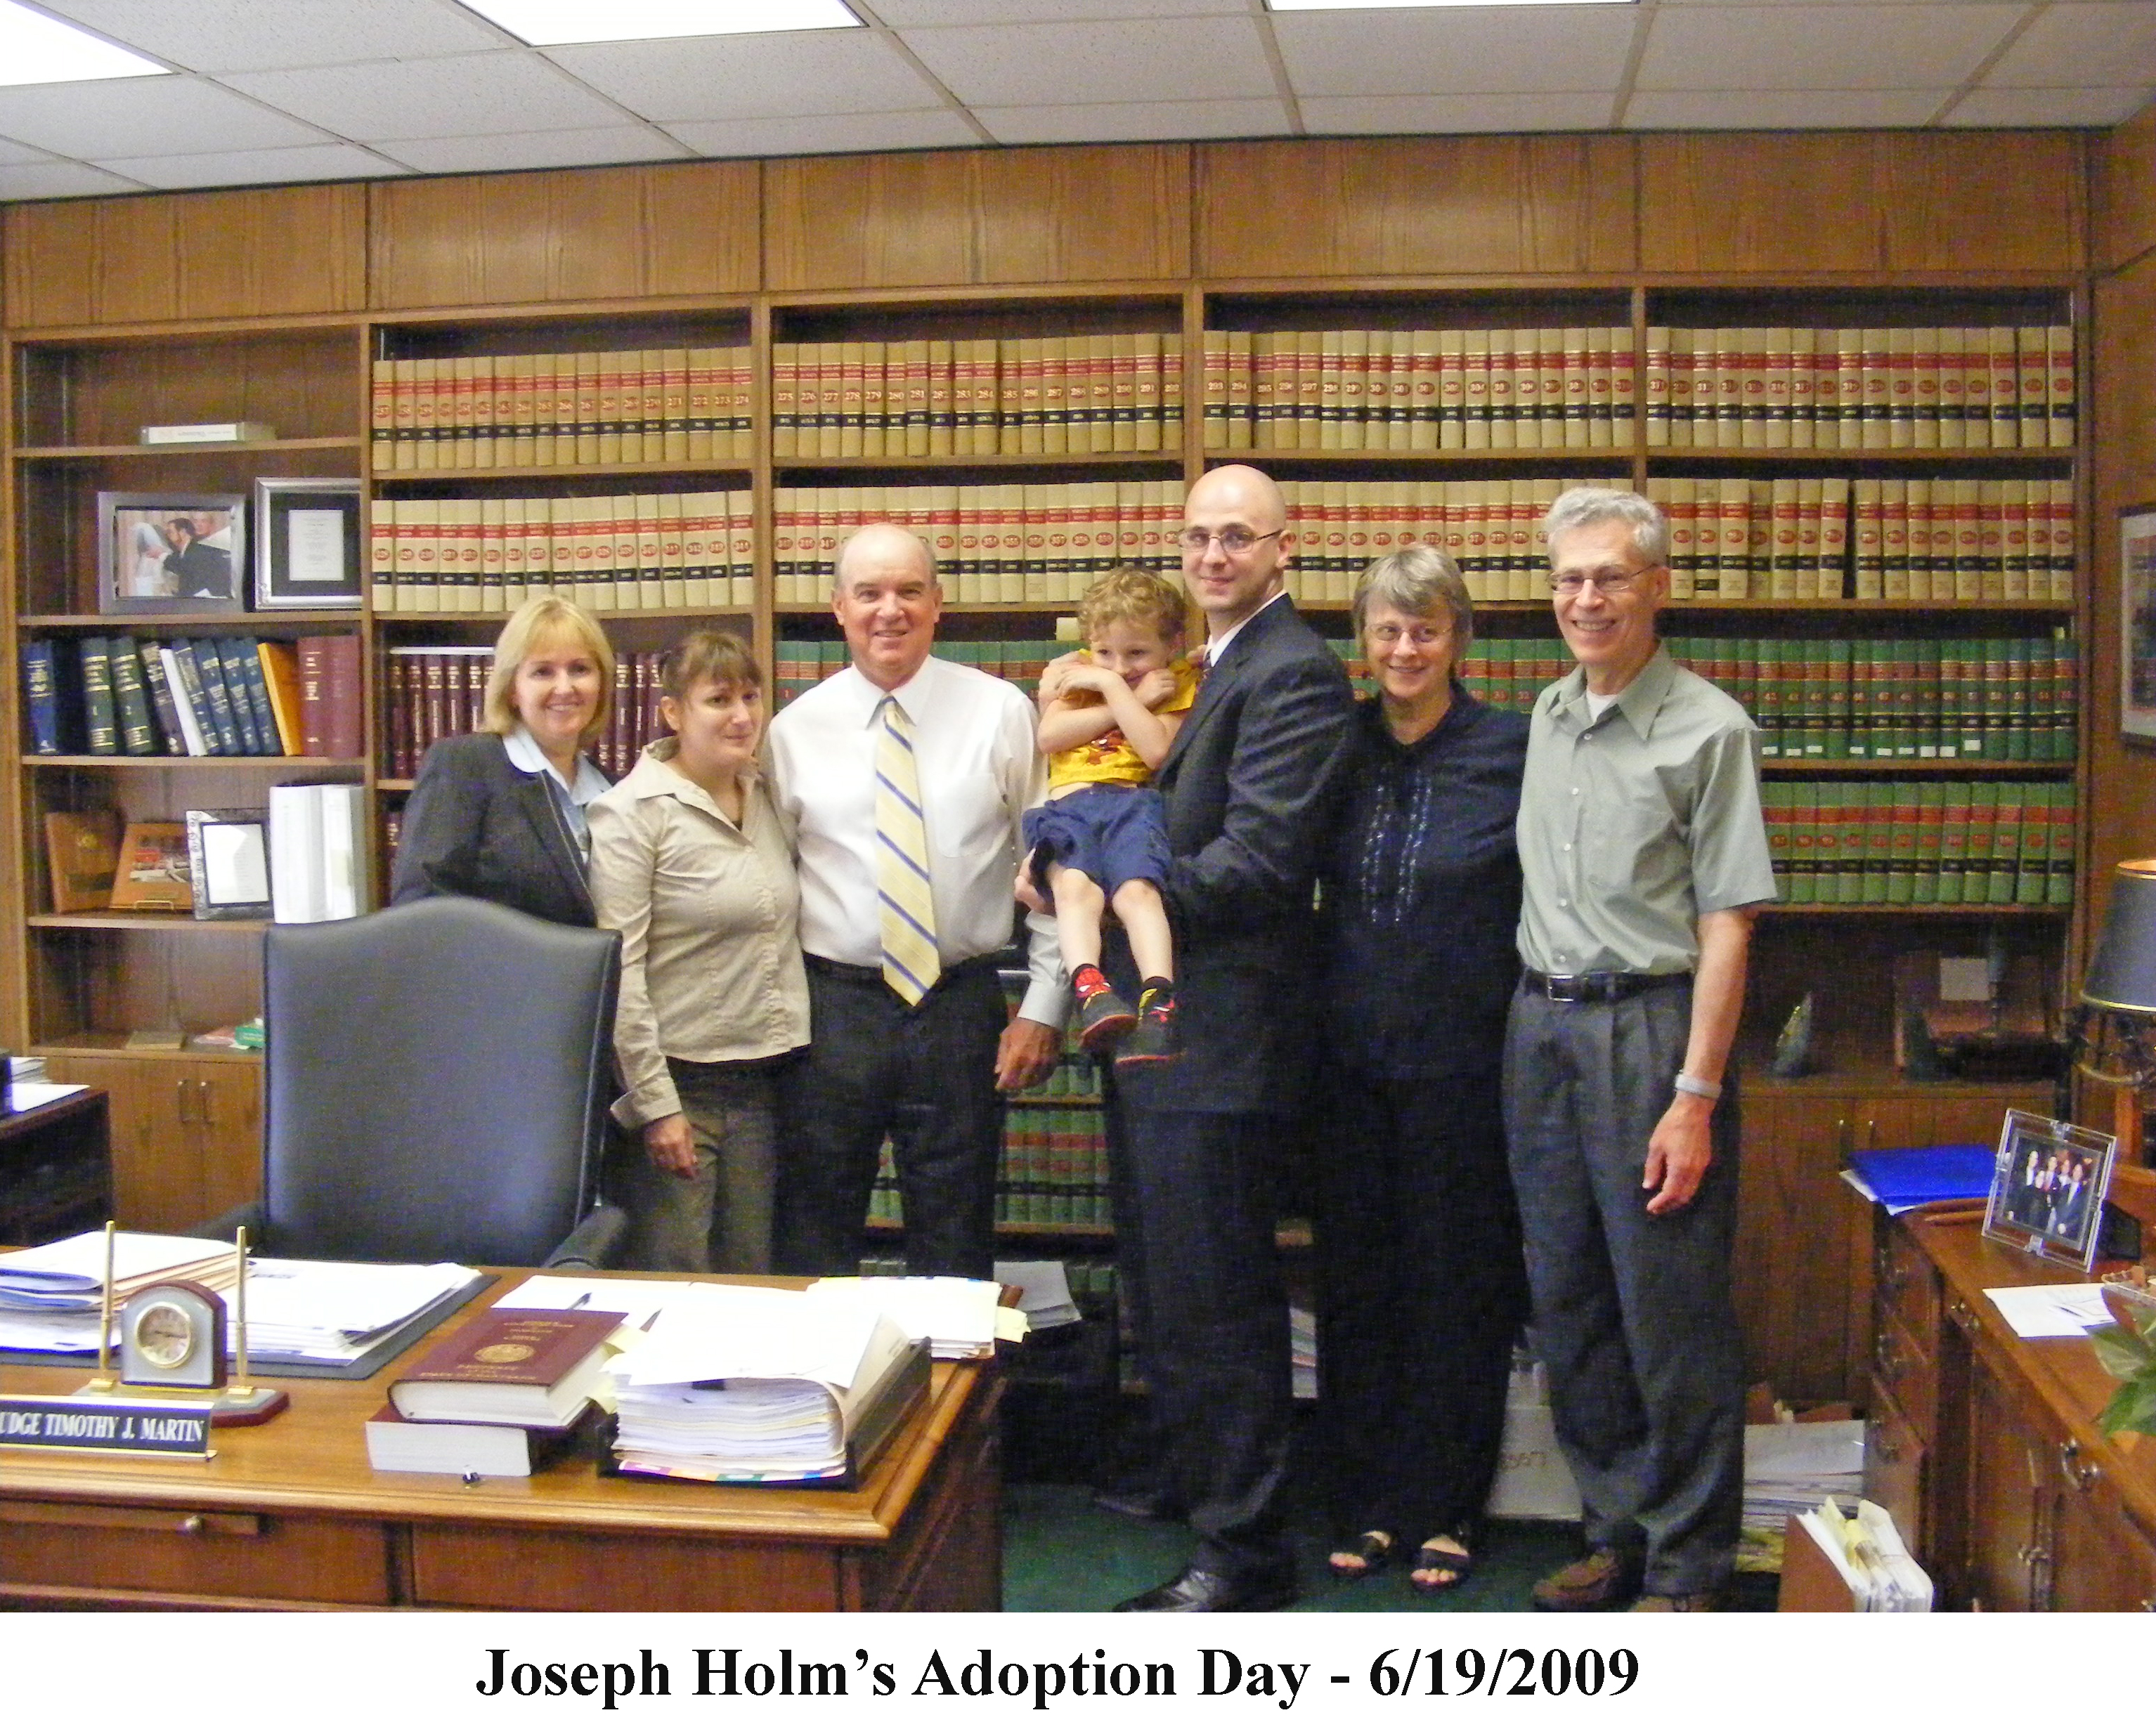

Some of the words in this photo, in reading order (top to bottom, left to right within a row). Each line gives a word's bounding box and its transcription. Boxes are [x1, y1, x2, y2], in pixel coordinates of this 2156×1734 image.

[1047, 388, 1063, 398] 287
[1140, 384, 1155, 393] 291
[777, 392, 794, 402] 275
[800, 392, 817, 401] 276
[823, 392, 839, 402] 277
[845, 391, 861, 400] 278
[865, 391, 881, 400] 279
[888, 391, 904, 400] 280
[909, 389, 925, 399] 281
[956, 389, 971, 399] 283
[977, 389, 994, 399] 284
[1002, 389, 1019, 399] 285
[667, 397, 682, 406] 271
[692, 396, 708, 405] 272
[714, 396, 731, 405] 273
[734, 395, 750, 405] 274
[44, 1414, 120, 1438] TIMOTHY
[122, 1416, 136, 1440] J.
[140, 1417, 204, 1442] MARTIN
